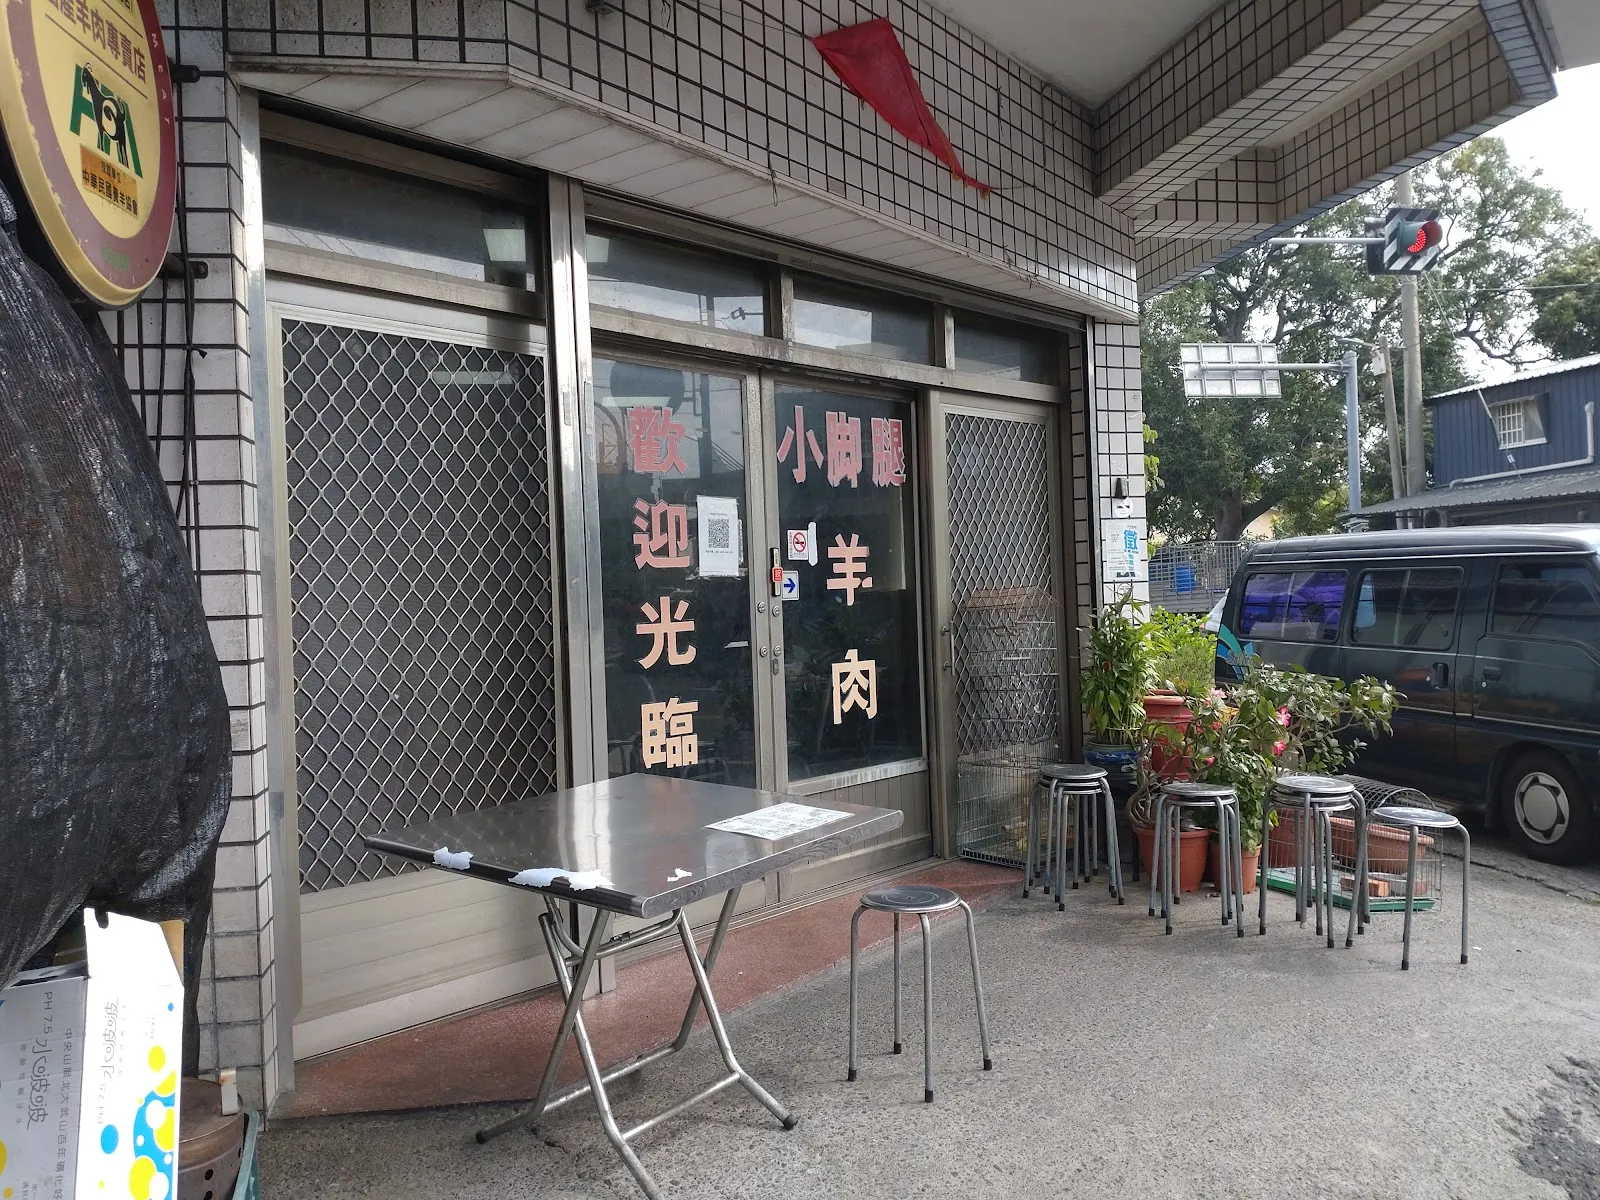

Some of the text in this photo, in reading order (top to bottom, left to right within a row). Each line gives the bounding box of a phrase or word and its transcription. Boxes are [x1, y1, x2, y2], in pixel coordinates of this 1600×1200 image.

[48, 0, 146, 84] 產羊肉專賣店
[626, 405, 699, 769] 歡迎光臨
[826, 533, 877, 724] 羊肉
[43, 991, 53, 1034] PH 7.5
